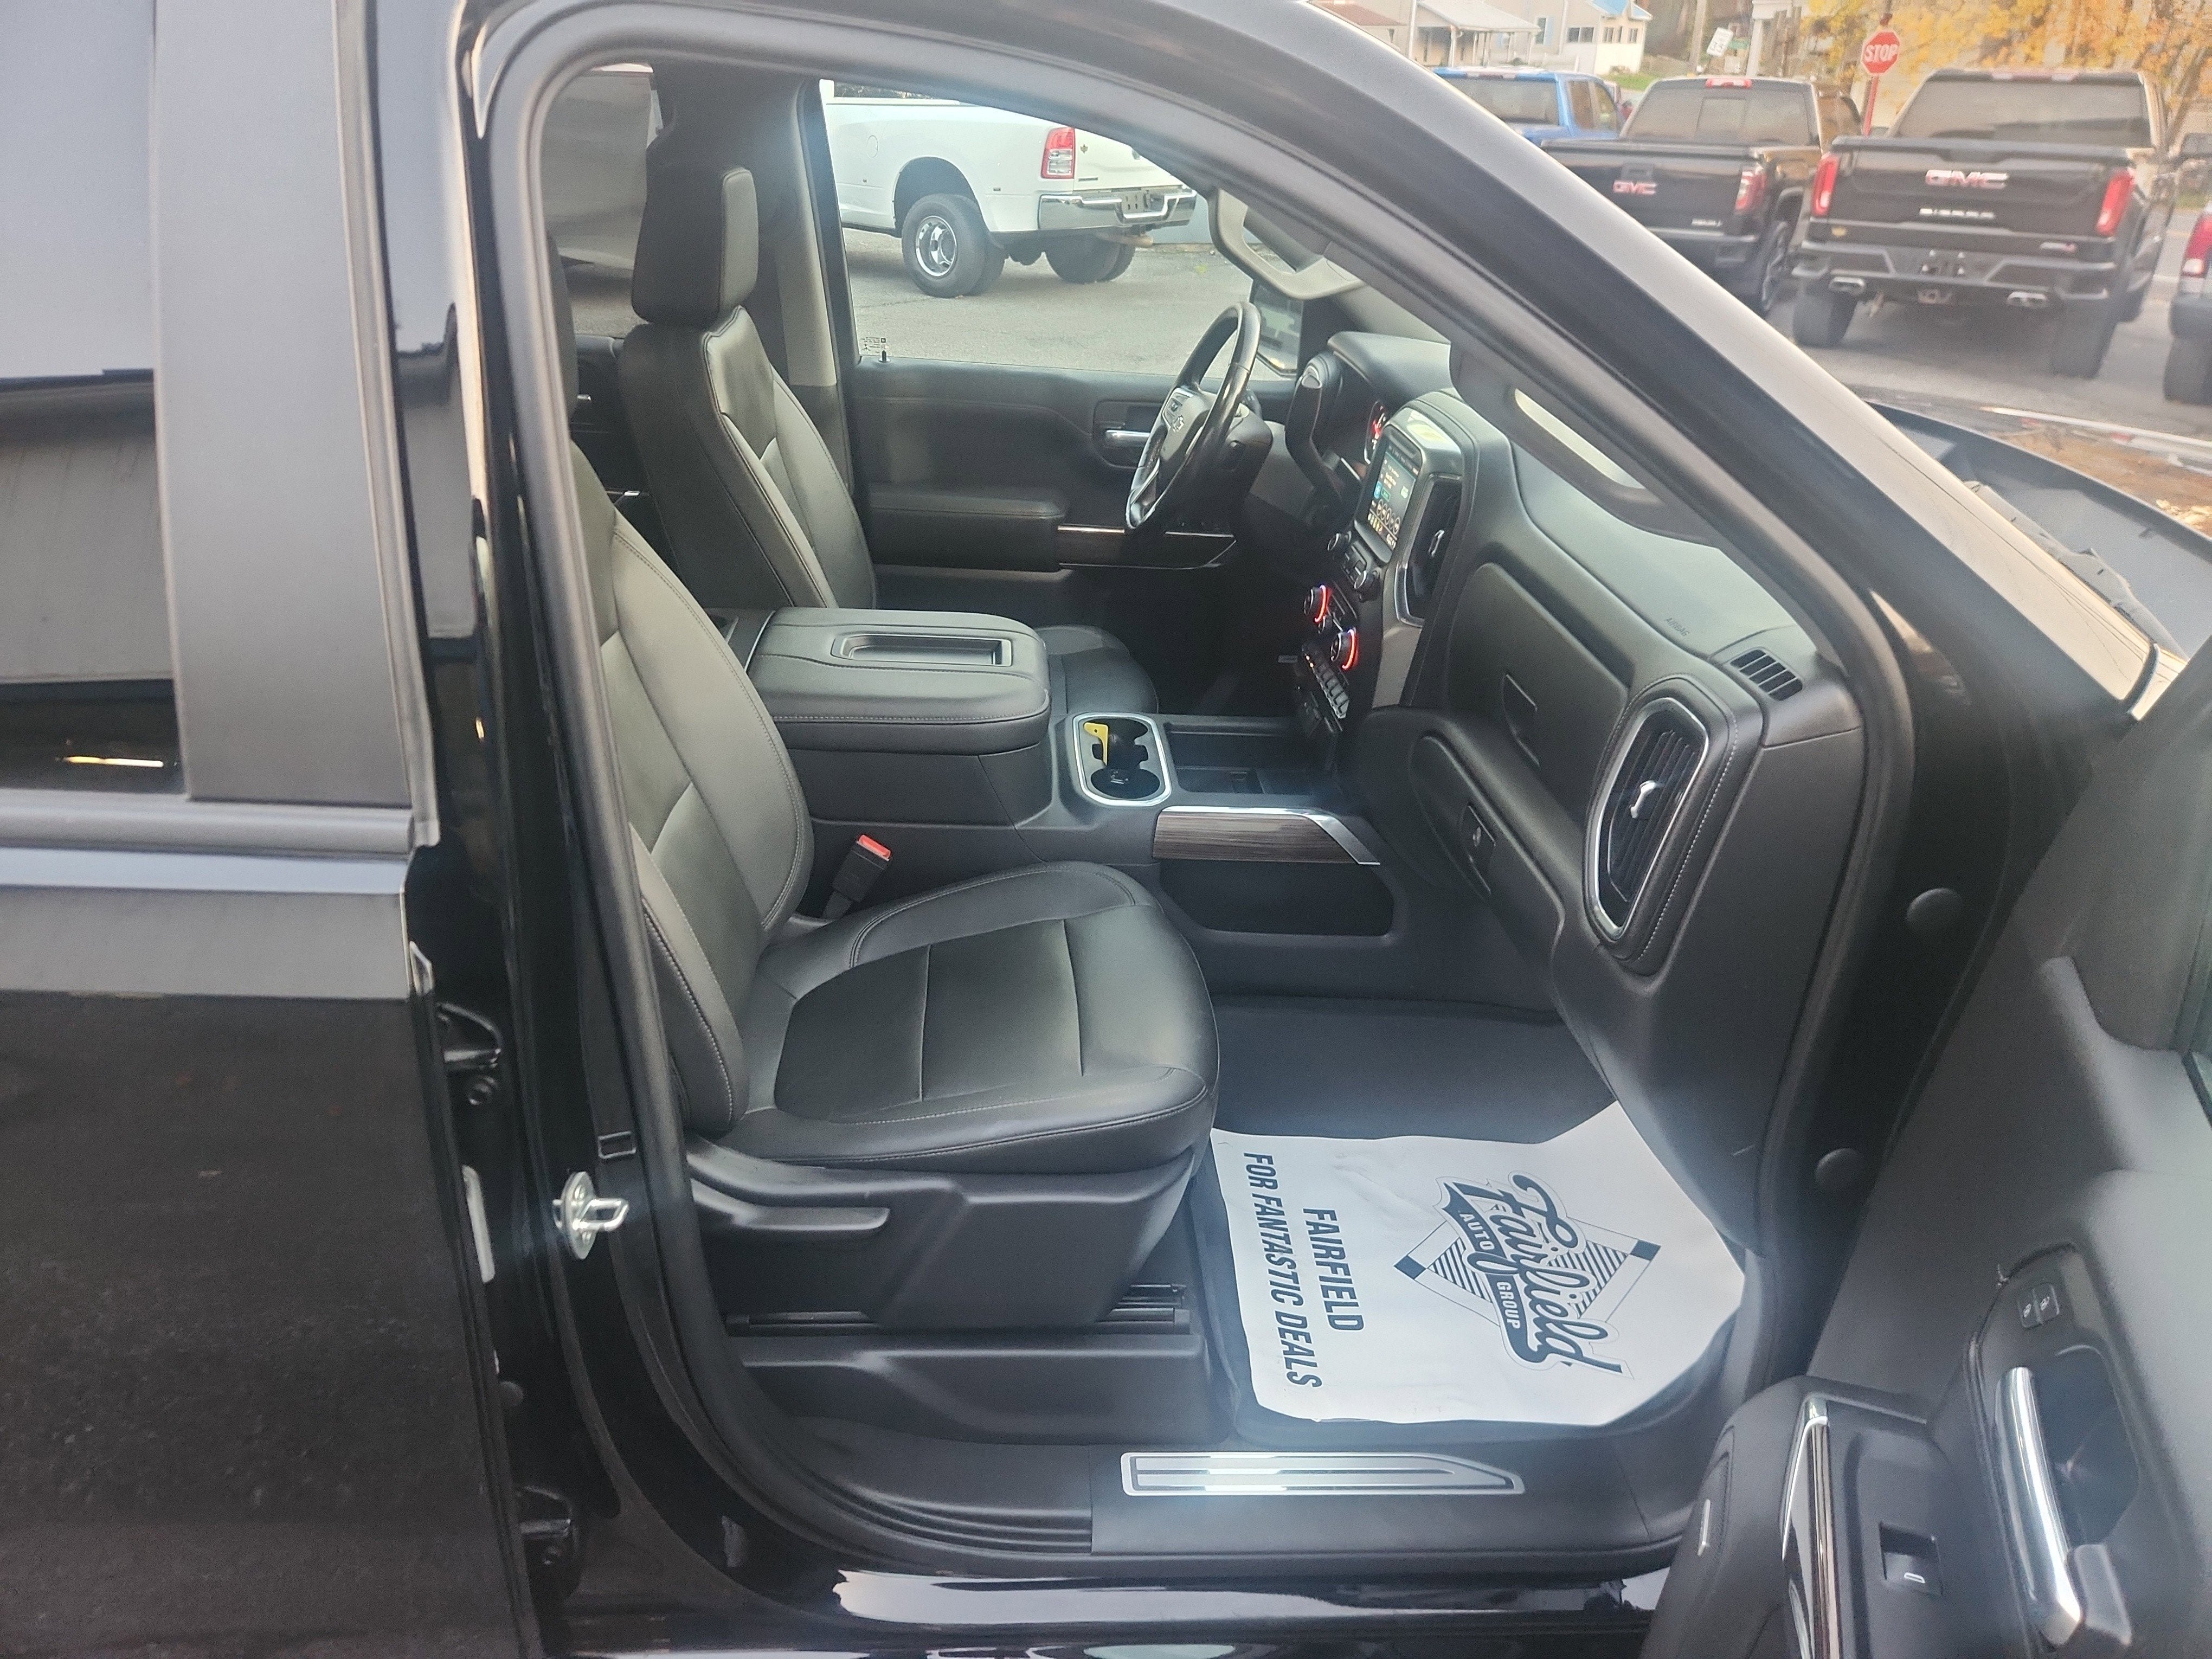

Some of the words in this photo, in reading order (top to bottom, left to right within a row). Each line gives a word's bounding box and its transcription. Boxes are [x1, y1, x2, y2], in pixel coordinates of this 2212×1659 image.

[1864, 43, 1898, 62] STOP
[1612, 180, 1657, 195] GMC
[1926, 164, 2009, 189] GMC
[1666, 618, 1690, 636] AIRBAG
[1243, 1152, 1278, 1190] FOR
[1251, 1193, 1304, 1306] FANTASTIC
[1303, 1208, 1364, 1331] FAIRFIELD
[1452, 1174, 1623, 1373] Fairfield
[1459, 1213, 1495, 1251] AUTO
[1496, 1281, 1521, 1329] GROUP
[1275, 1310, 1322, 1387] DEALS
